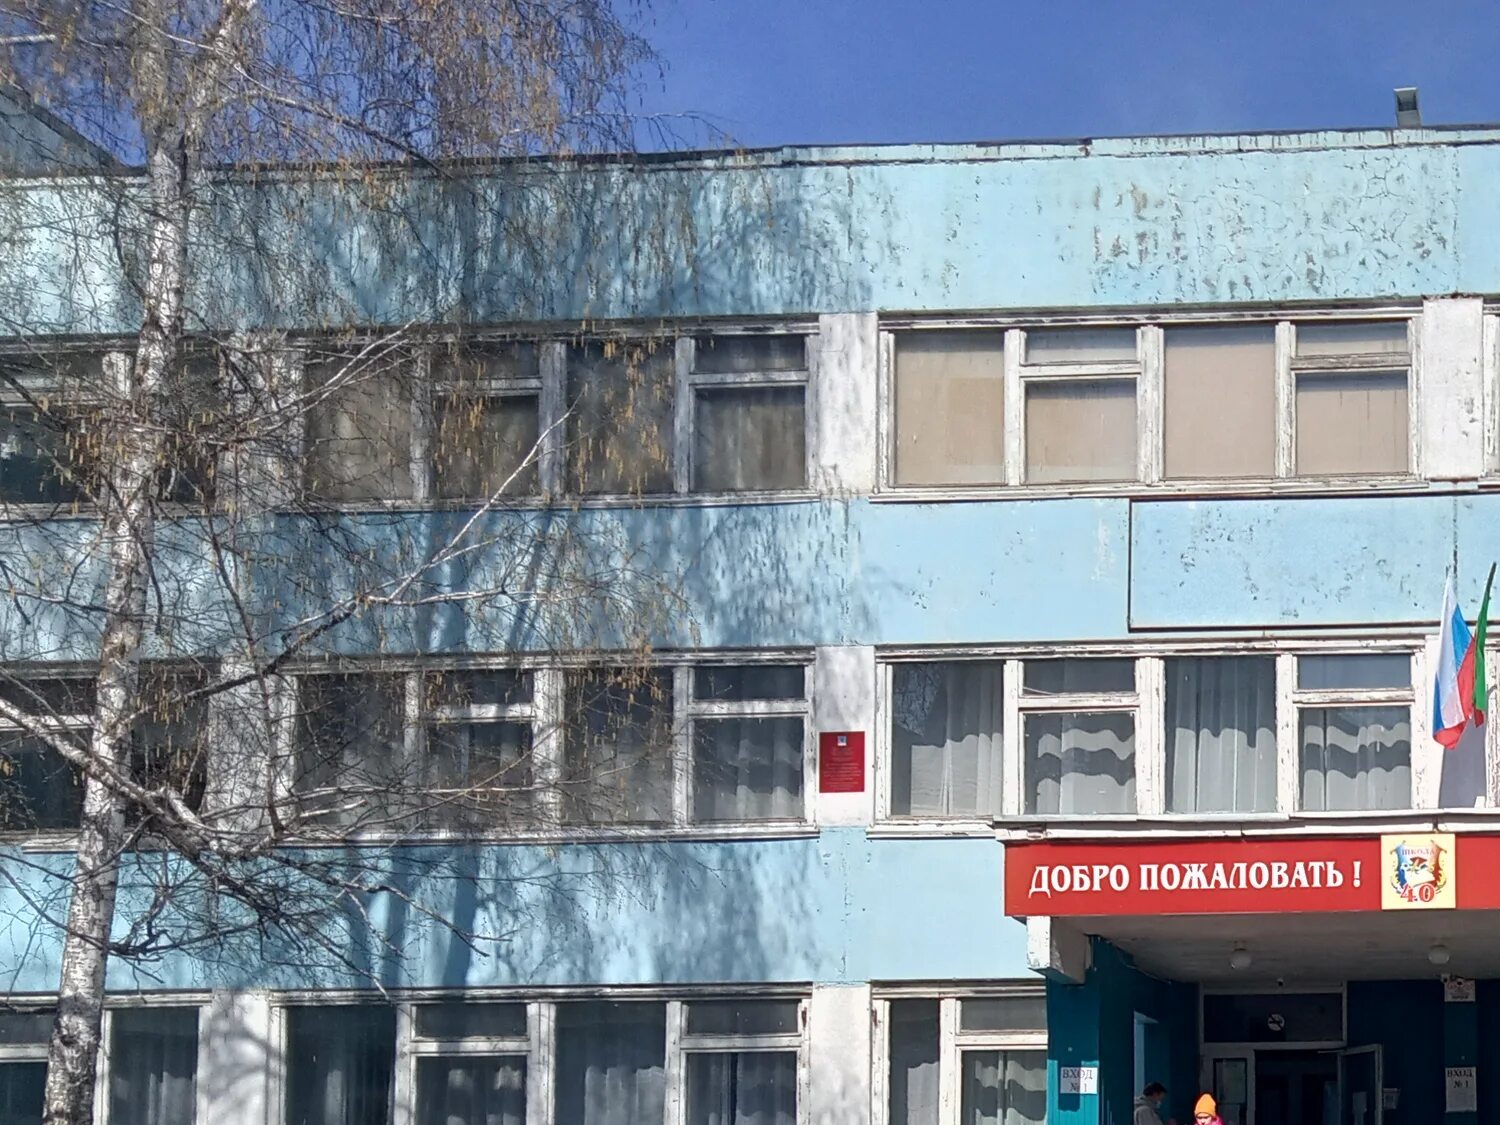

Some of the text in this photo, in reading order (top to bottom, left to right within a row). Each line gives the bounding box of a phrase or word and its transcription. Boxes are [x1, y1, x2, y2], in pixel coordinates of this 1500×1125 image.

[1028, 863, 1130, 898] ДОБРО
[1138, 861, 1344, 891] ПОЖАЛОВАТЬ
[1400, 883, 1435, 903] 40
[1062, 1068, 1093, 1080] ВХОД
[1447, 1068, 1473, 1078] ВХОД
